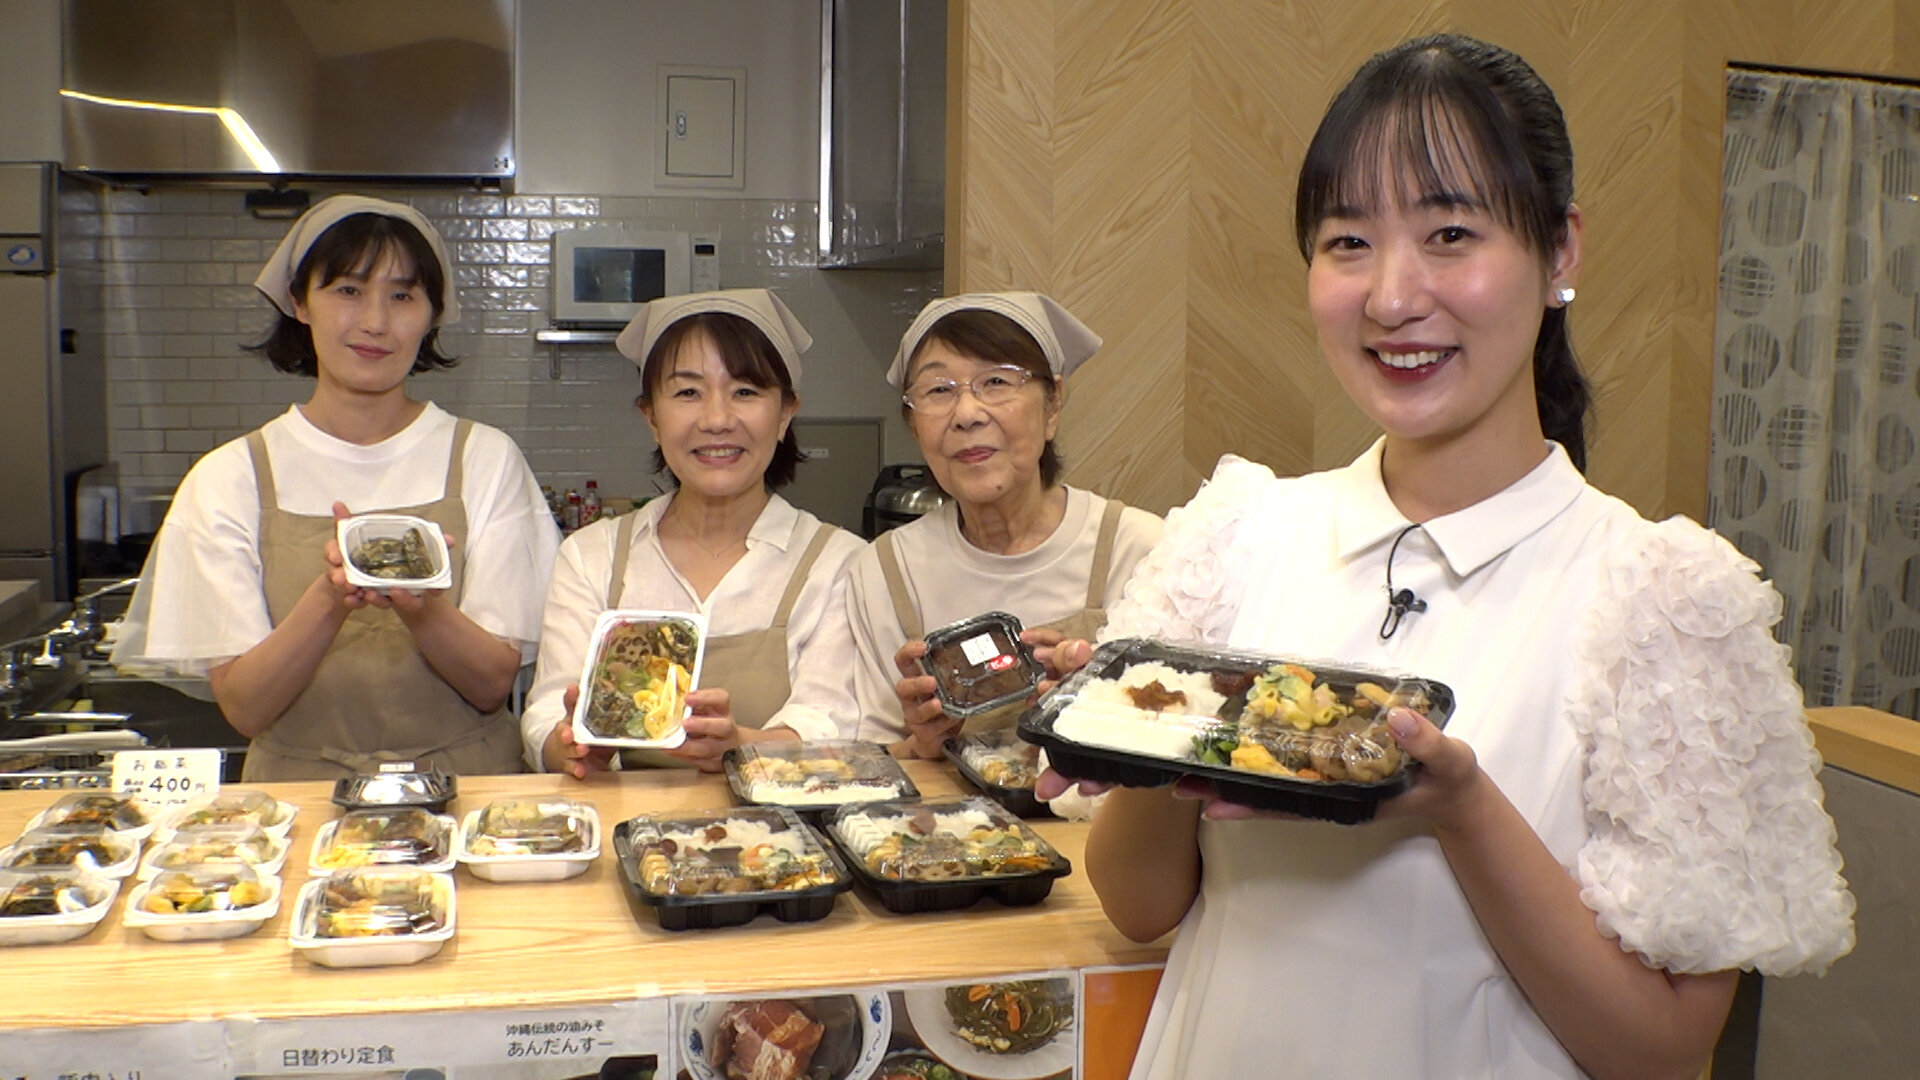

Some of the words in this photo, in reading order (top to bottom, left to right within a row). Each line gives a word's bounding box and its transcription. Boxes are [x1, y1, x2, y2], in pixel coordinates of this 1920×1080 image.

[506, 1019, 605, 1035] 沖縄伝統の油みそ
[283, 1044, 395, 1066] 日替わり定食
[507, 1036, 613, 1057] あんだんすー
